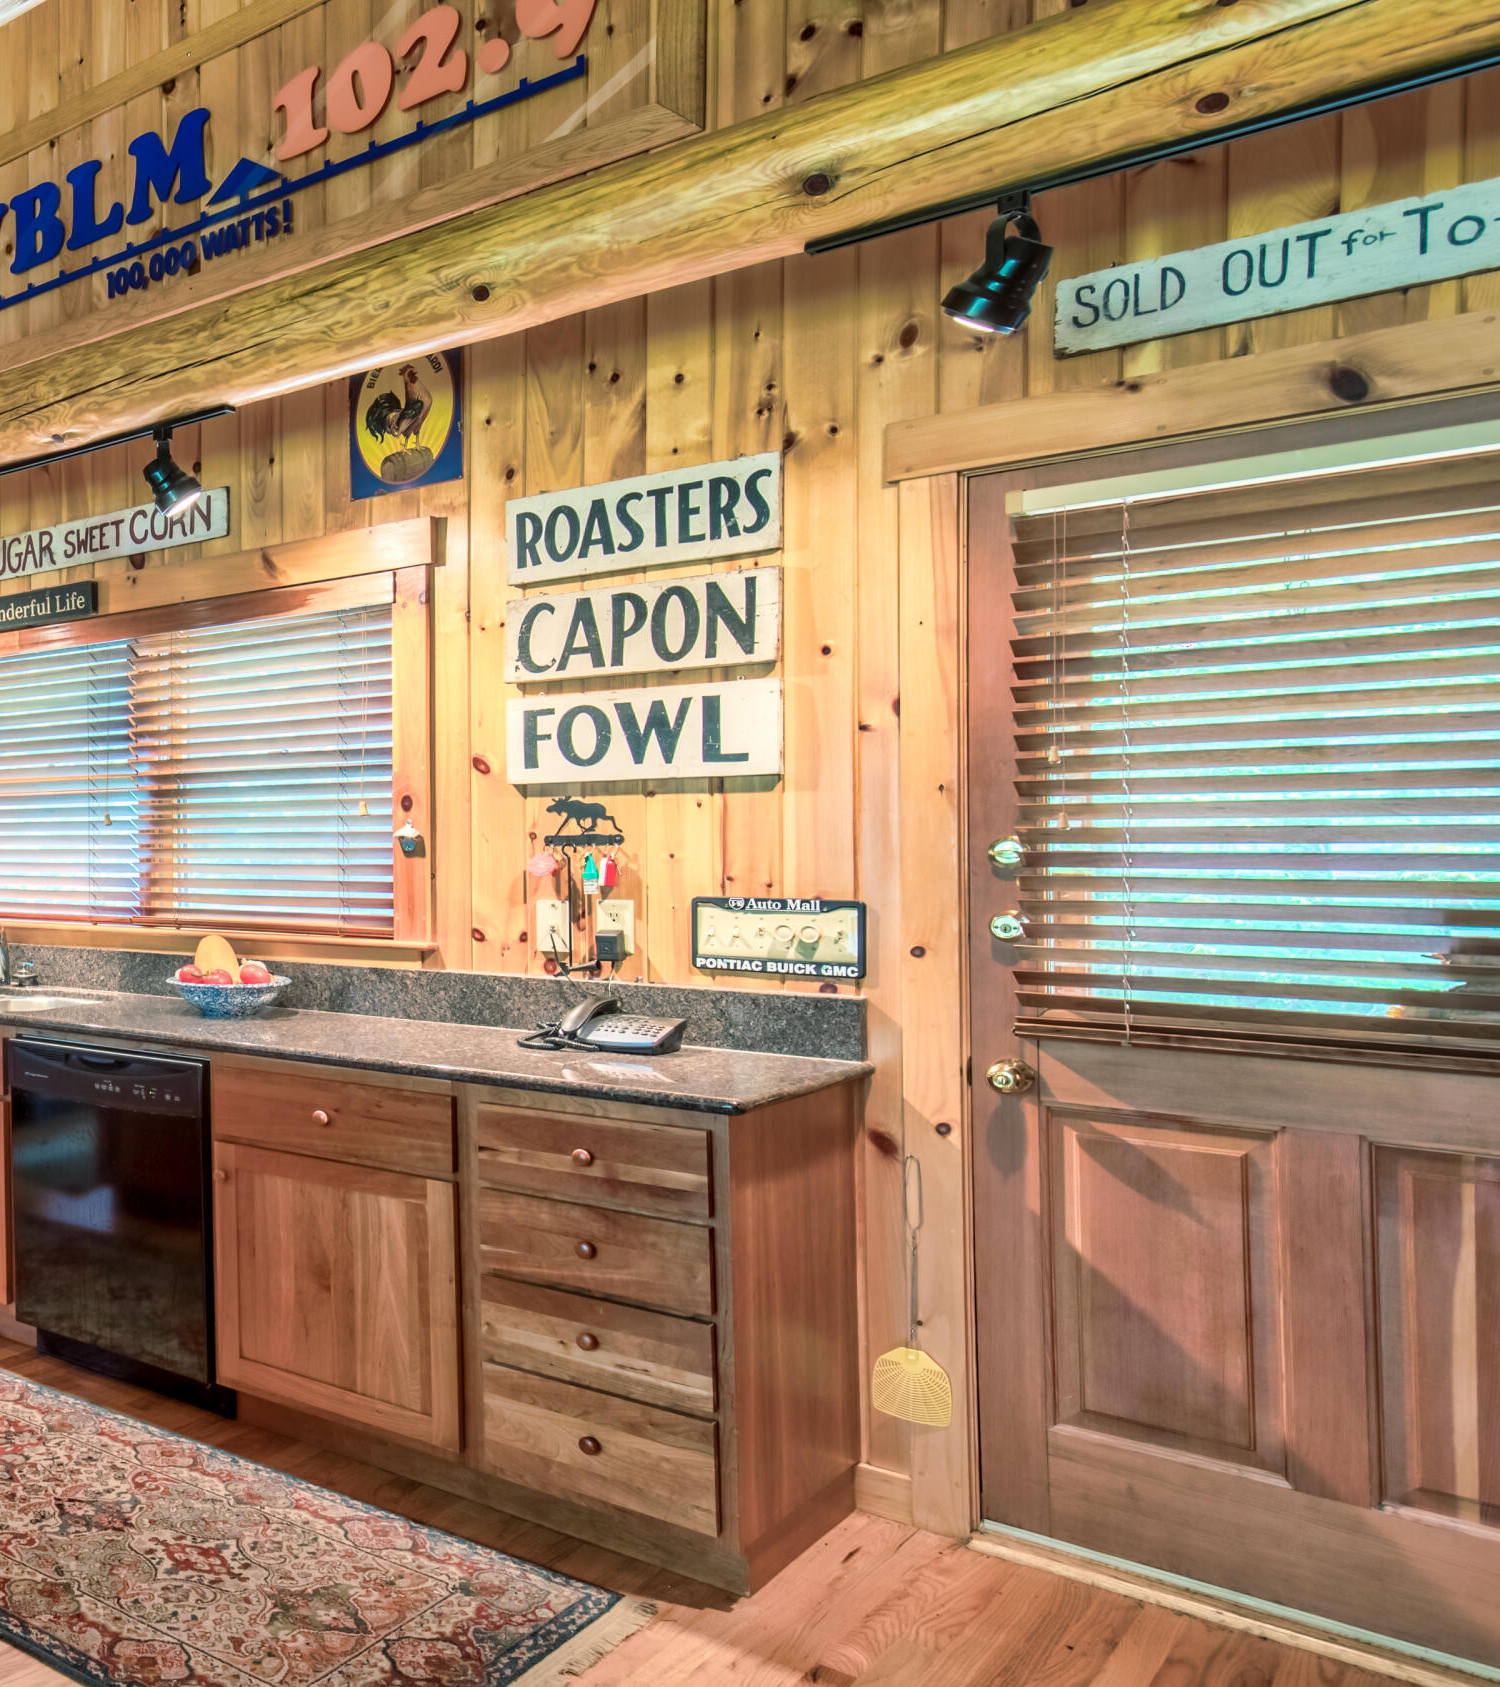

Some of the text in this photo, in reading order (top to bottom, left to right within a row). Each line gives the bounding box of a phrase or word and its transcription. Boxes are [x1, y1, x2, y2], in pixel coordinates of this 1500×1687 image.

[274, 0, 597, 161] 102.9
[106, 199, 293, 299] 100,000 WATTS!
[1071, 202, 1500, 329] SOLD OUT for To
[63, 518, 125, 559] SWEET
[129, 494, 212, 545] CORN
[515, 469, 773, 570] ROASTERS
[55, 592, 86, 613] Life
[517, 576, 758, 674] CAPON
[523, 695, 750, 770] FOWL
[745, 898, 782, 911] Auto
[786, 899, 820, 911] Mall
[696, 958, 859, 977] PONTIAC BUICK GMC
